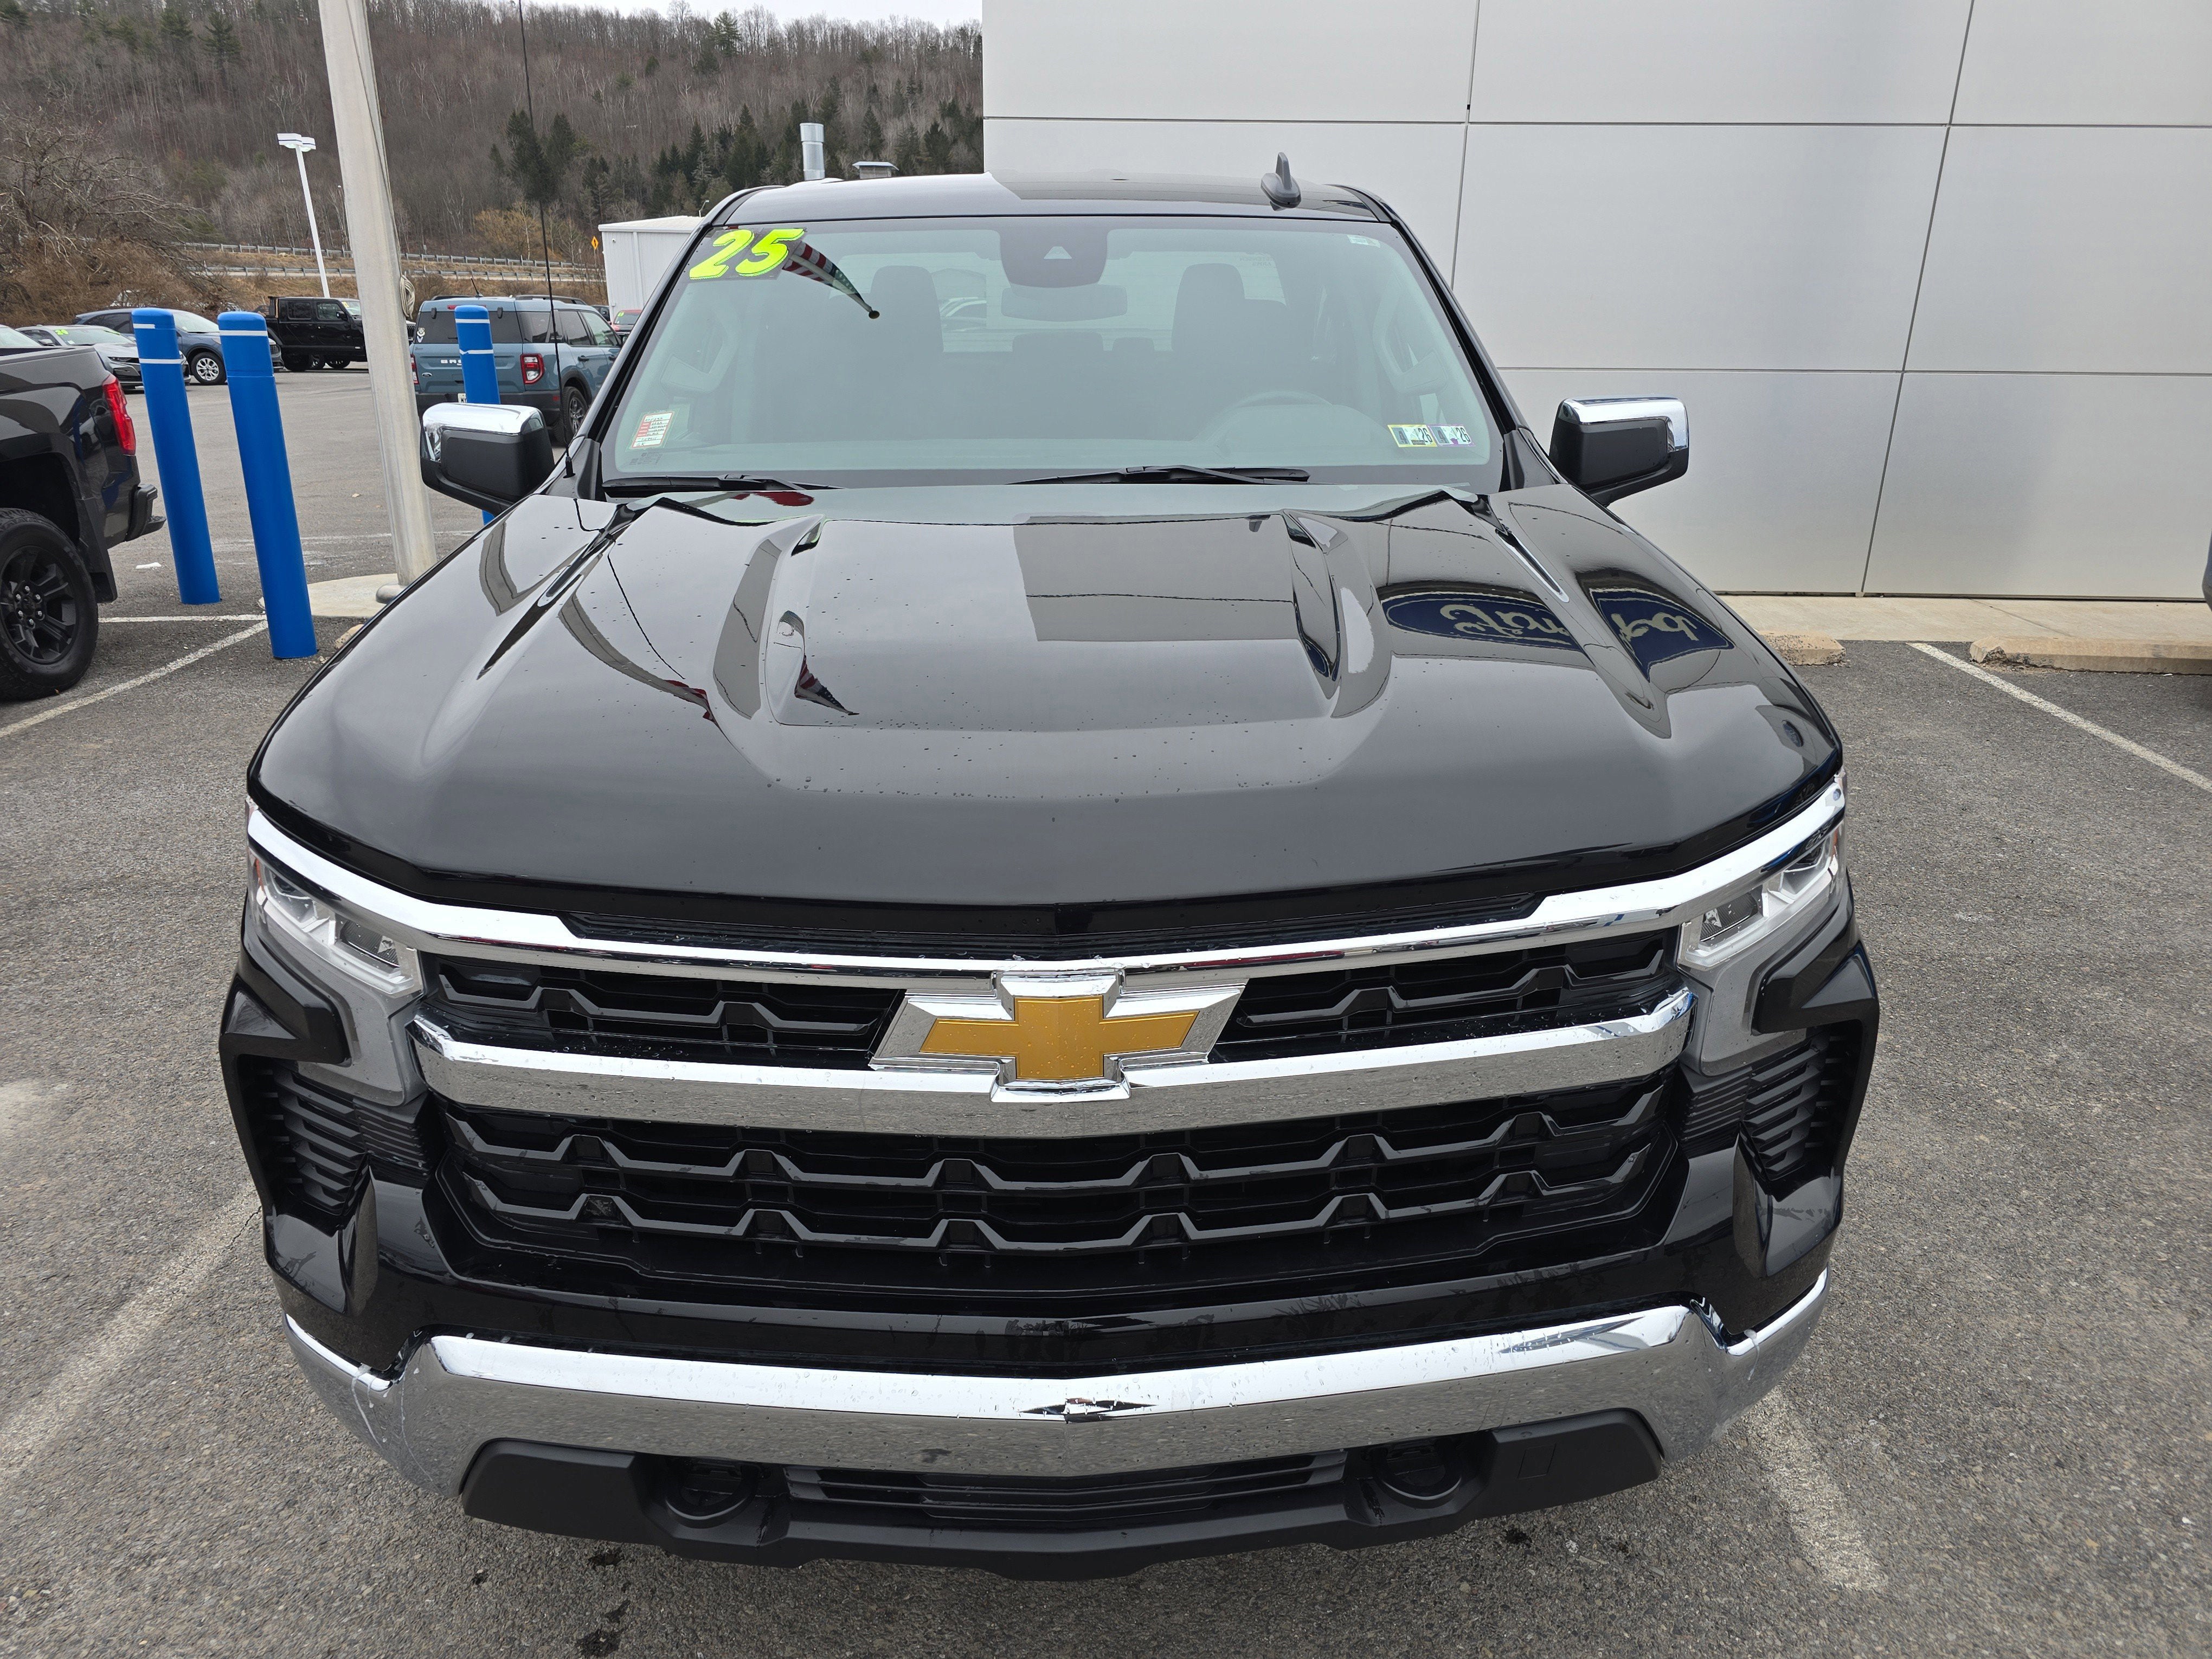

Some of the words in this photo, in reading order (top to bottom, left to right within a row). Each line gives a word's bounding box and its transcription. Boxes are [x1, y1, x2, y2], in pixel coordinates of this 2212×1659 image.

[689, 228, 805, 280] 25
[1418, 428, 1432, 442] 26
[1456, 427, 1470, 442] 26
